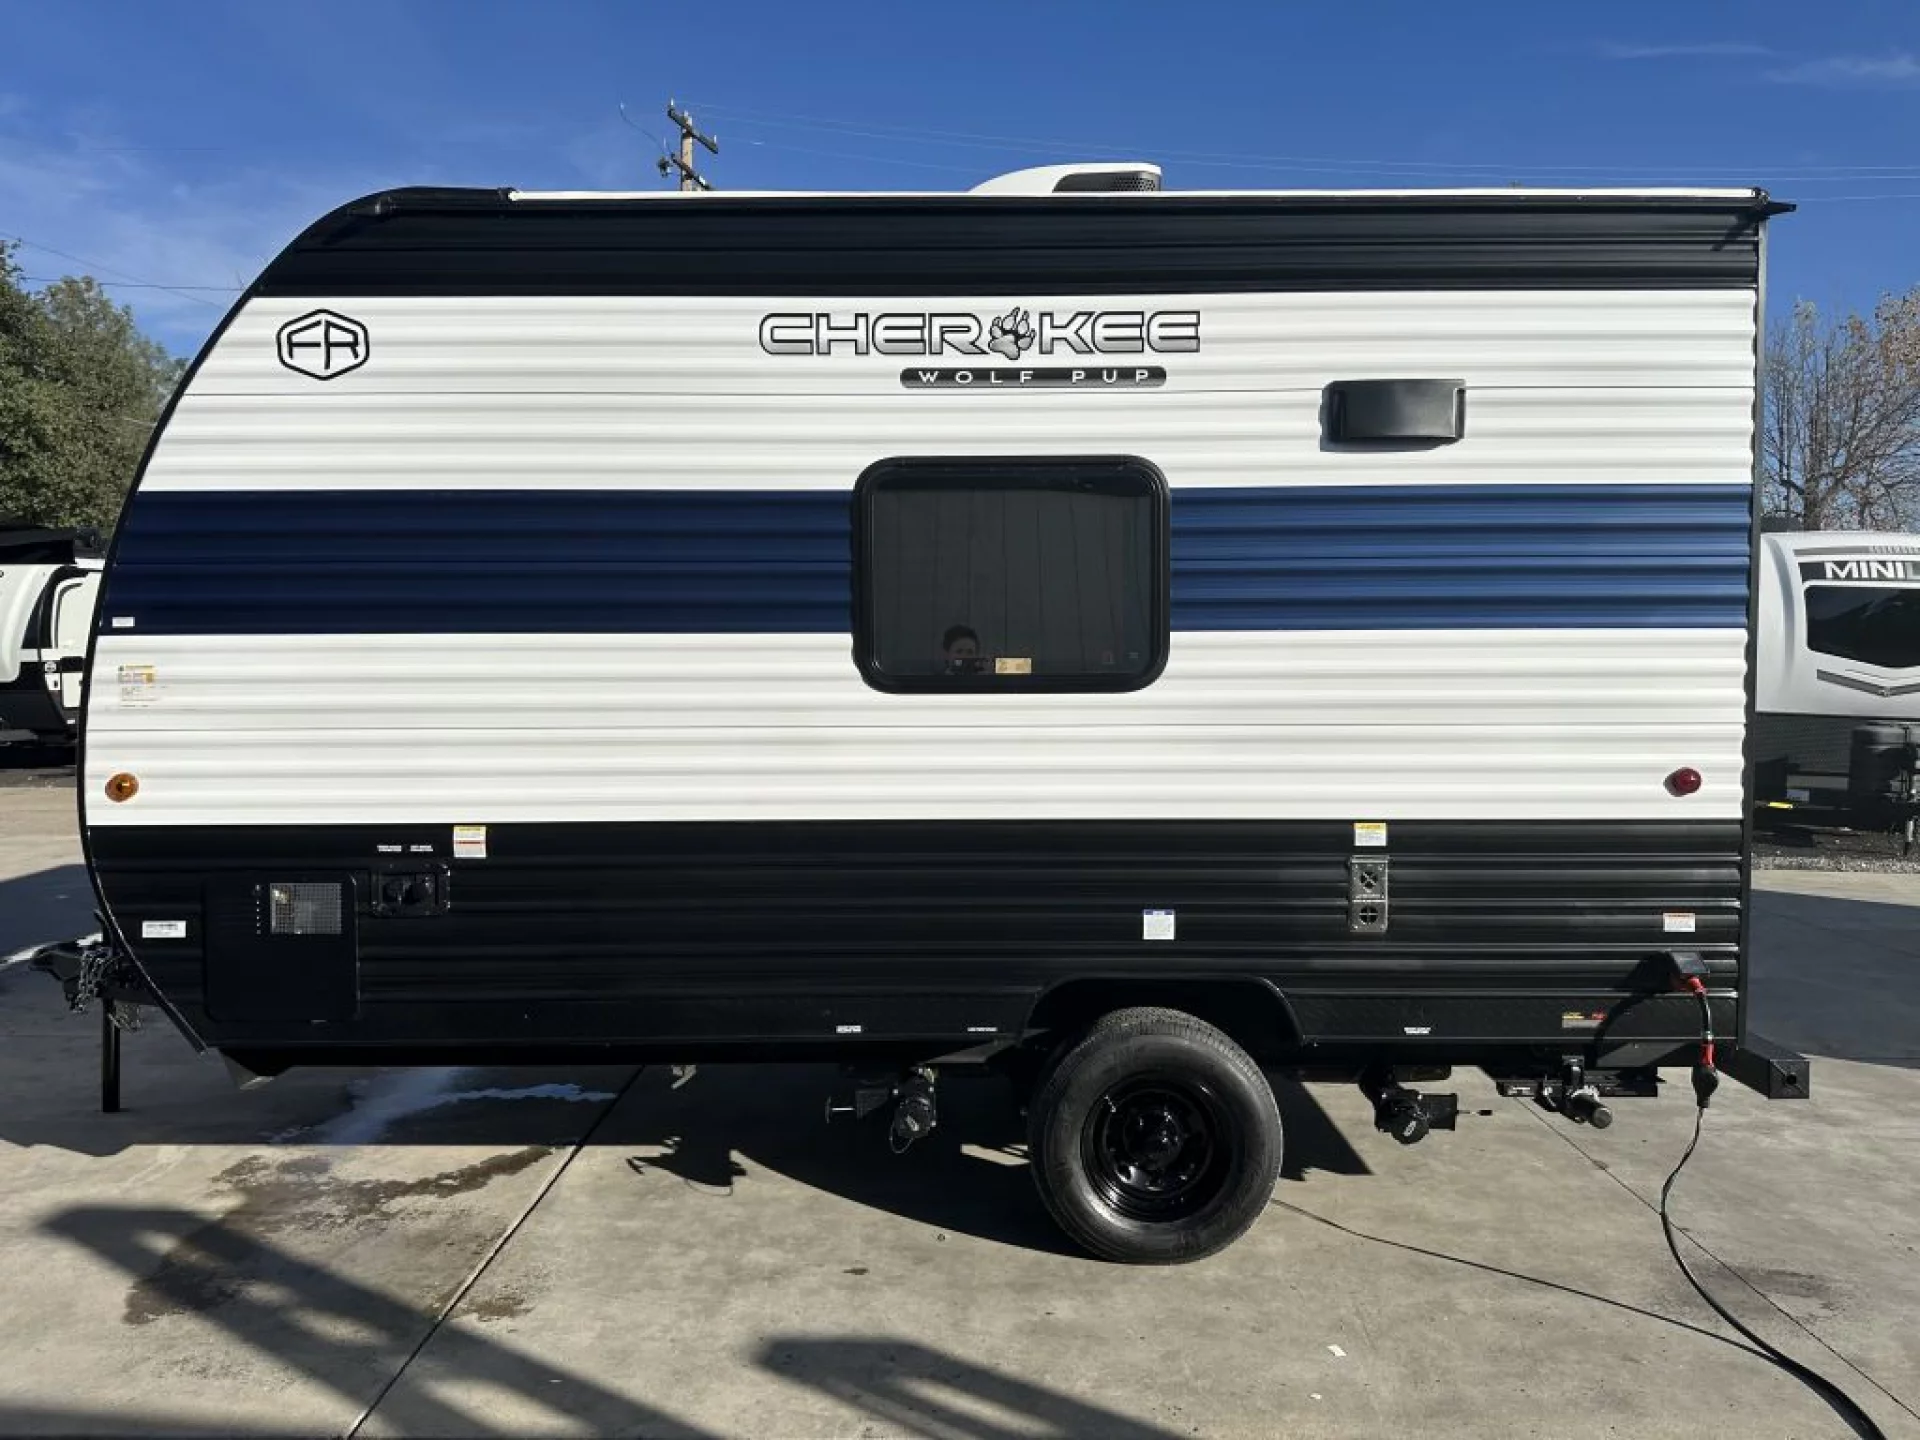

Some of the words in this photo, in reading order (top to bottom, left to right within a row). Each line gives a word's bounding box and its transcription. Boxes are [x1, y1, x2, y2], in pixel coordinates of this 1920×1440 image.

[287, 320, 359, 370] FR
[918, 370, 1033, 384] WOLF
[1072, 370, 1149, 383] PUP
